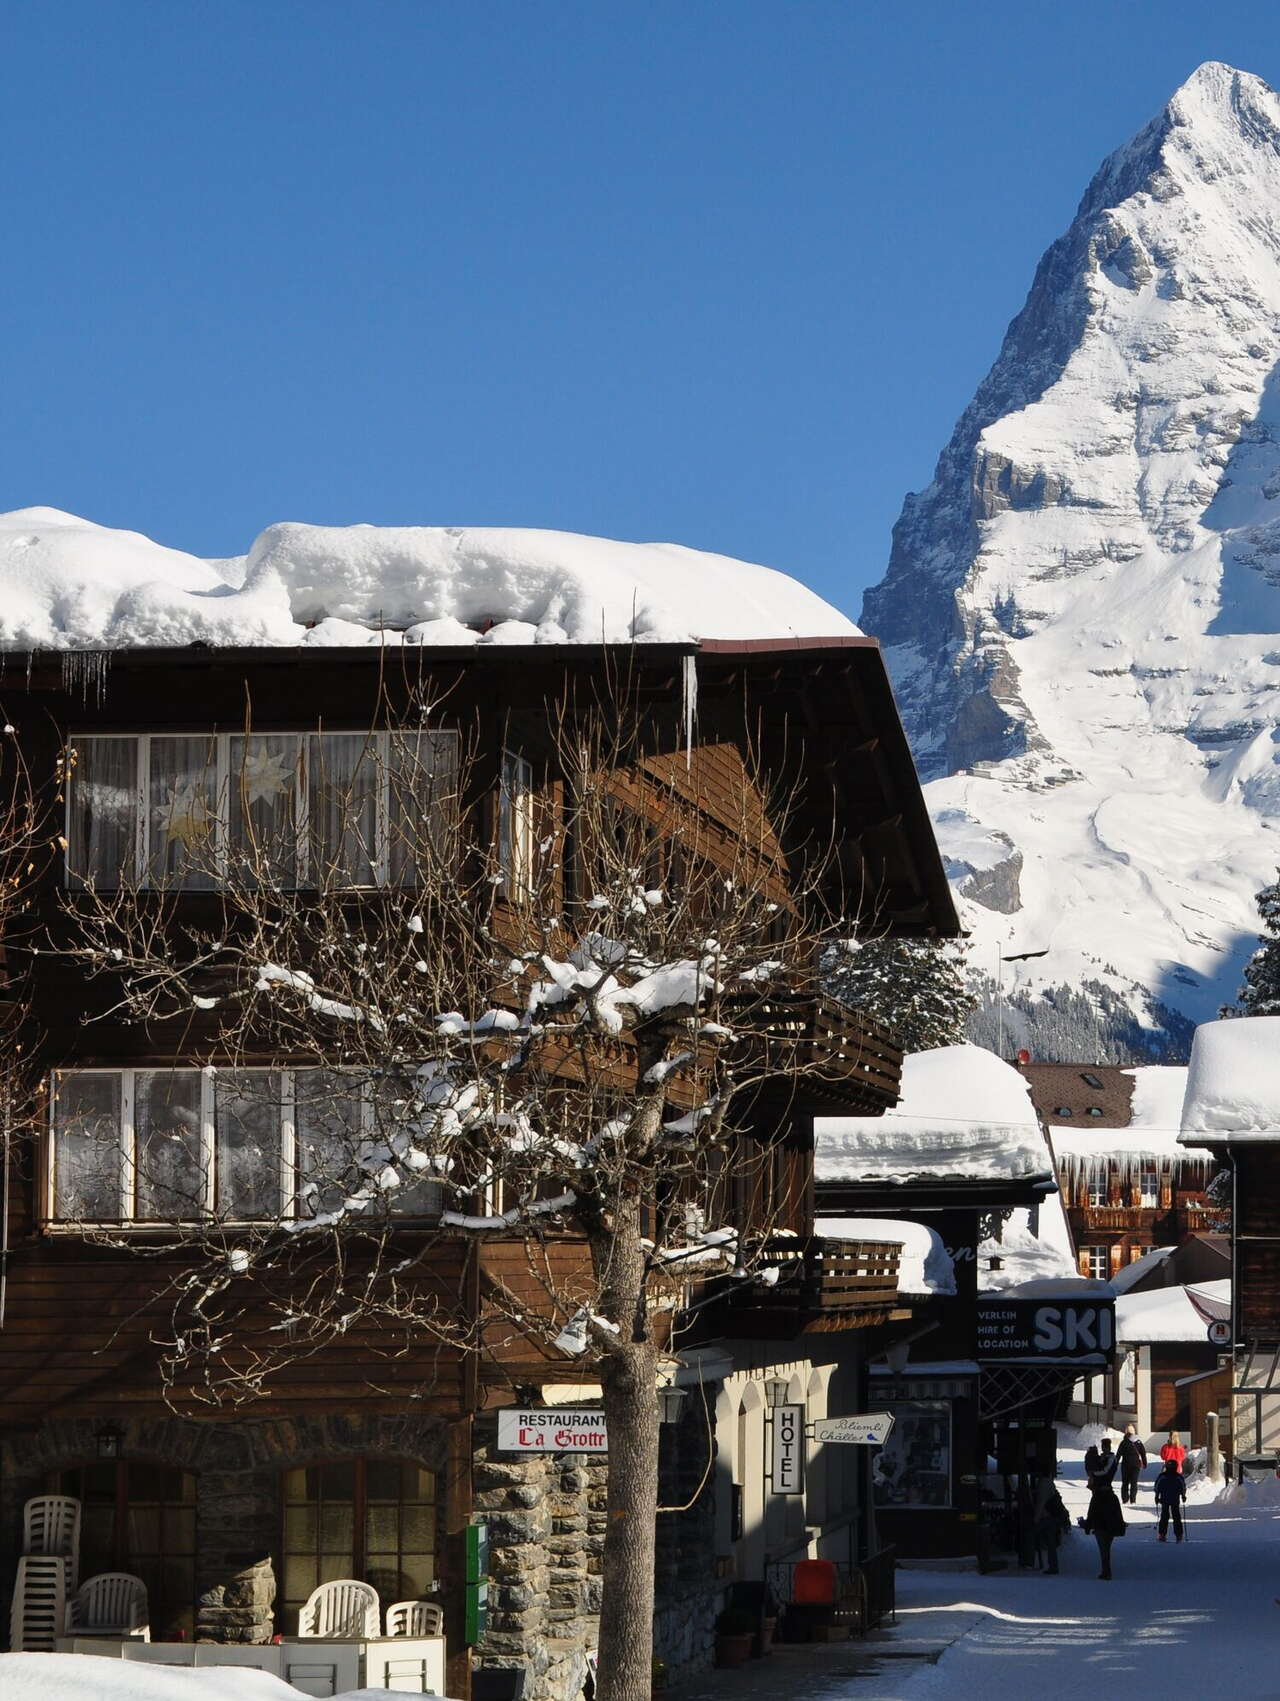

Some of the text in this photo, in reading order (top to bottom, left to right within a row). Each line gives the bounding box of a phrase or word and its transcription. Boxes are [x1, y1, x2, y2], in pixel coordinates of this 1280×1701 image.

[977, 1311, 1017, 1320] VERLEIH
[977, 1325, 999, 1335] HIRE
[1034, 1306, 1112, 1350] SKI
[977, 1339, 1029, 1349] LOCATION
[519, 1414, 607, 1426] RESTAURANT
[519, 1427, 606, 1447] La Grotte
[780, 1412, 795, 1488] HOTEL
